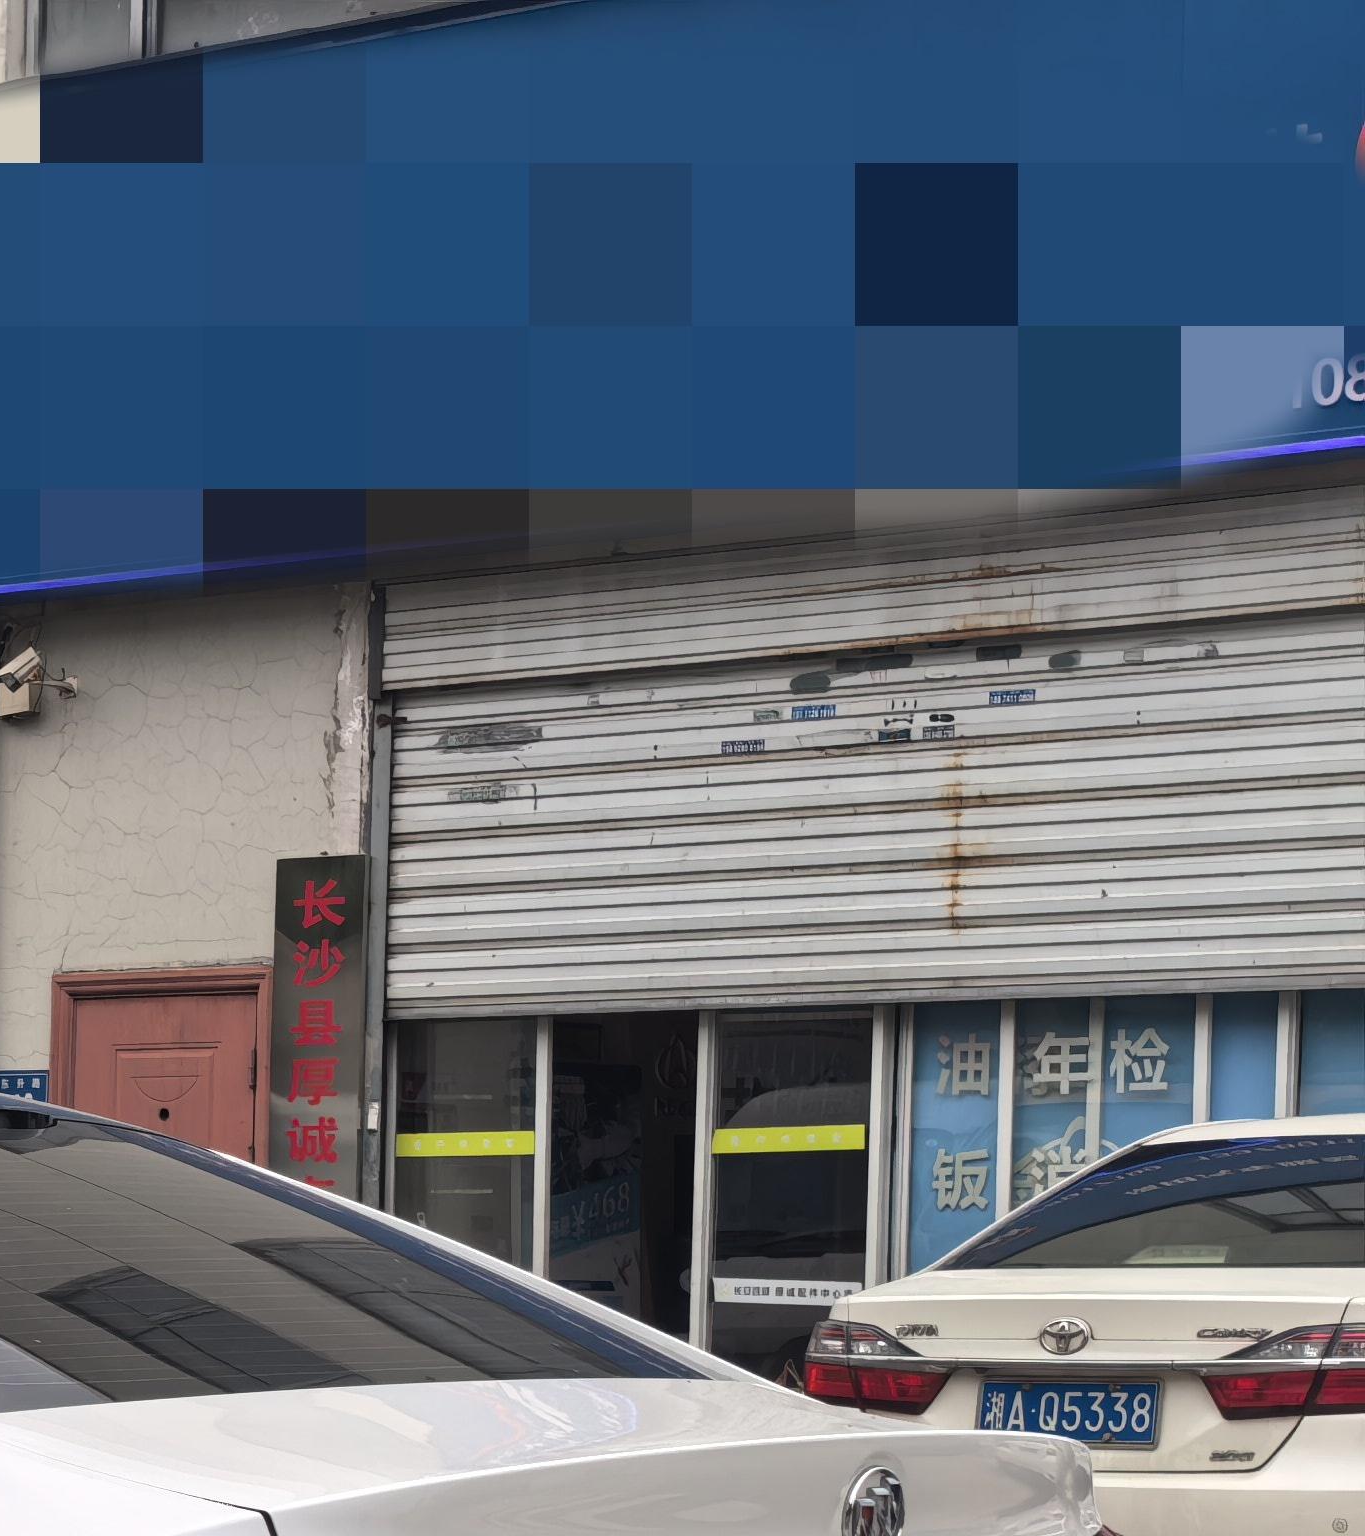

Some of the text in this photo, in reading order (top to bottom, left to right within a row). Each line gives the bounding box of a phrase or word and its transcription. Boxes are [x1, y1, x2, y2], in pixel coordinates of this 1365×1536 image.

[287, 879, 347, 1188] 长沙县厚诚
